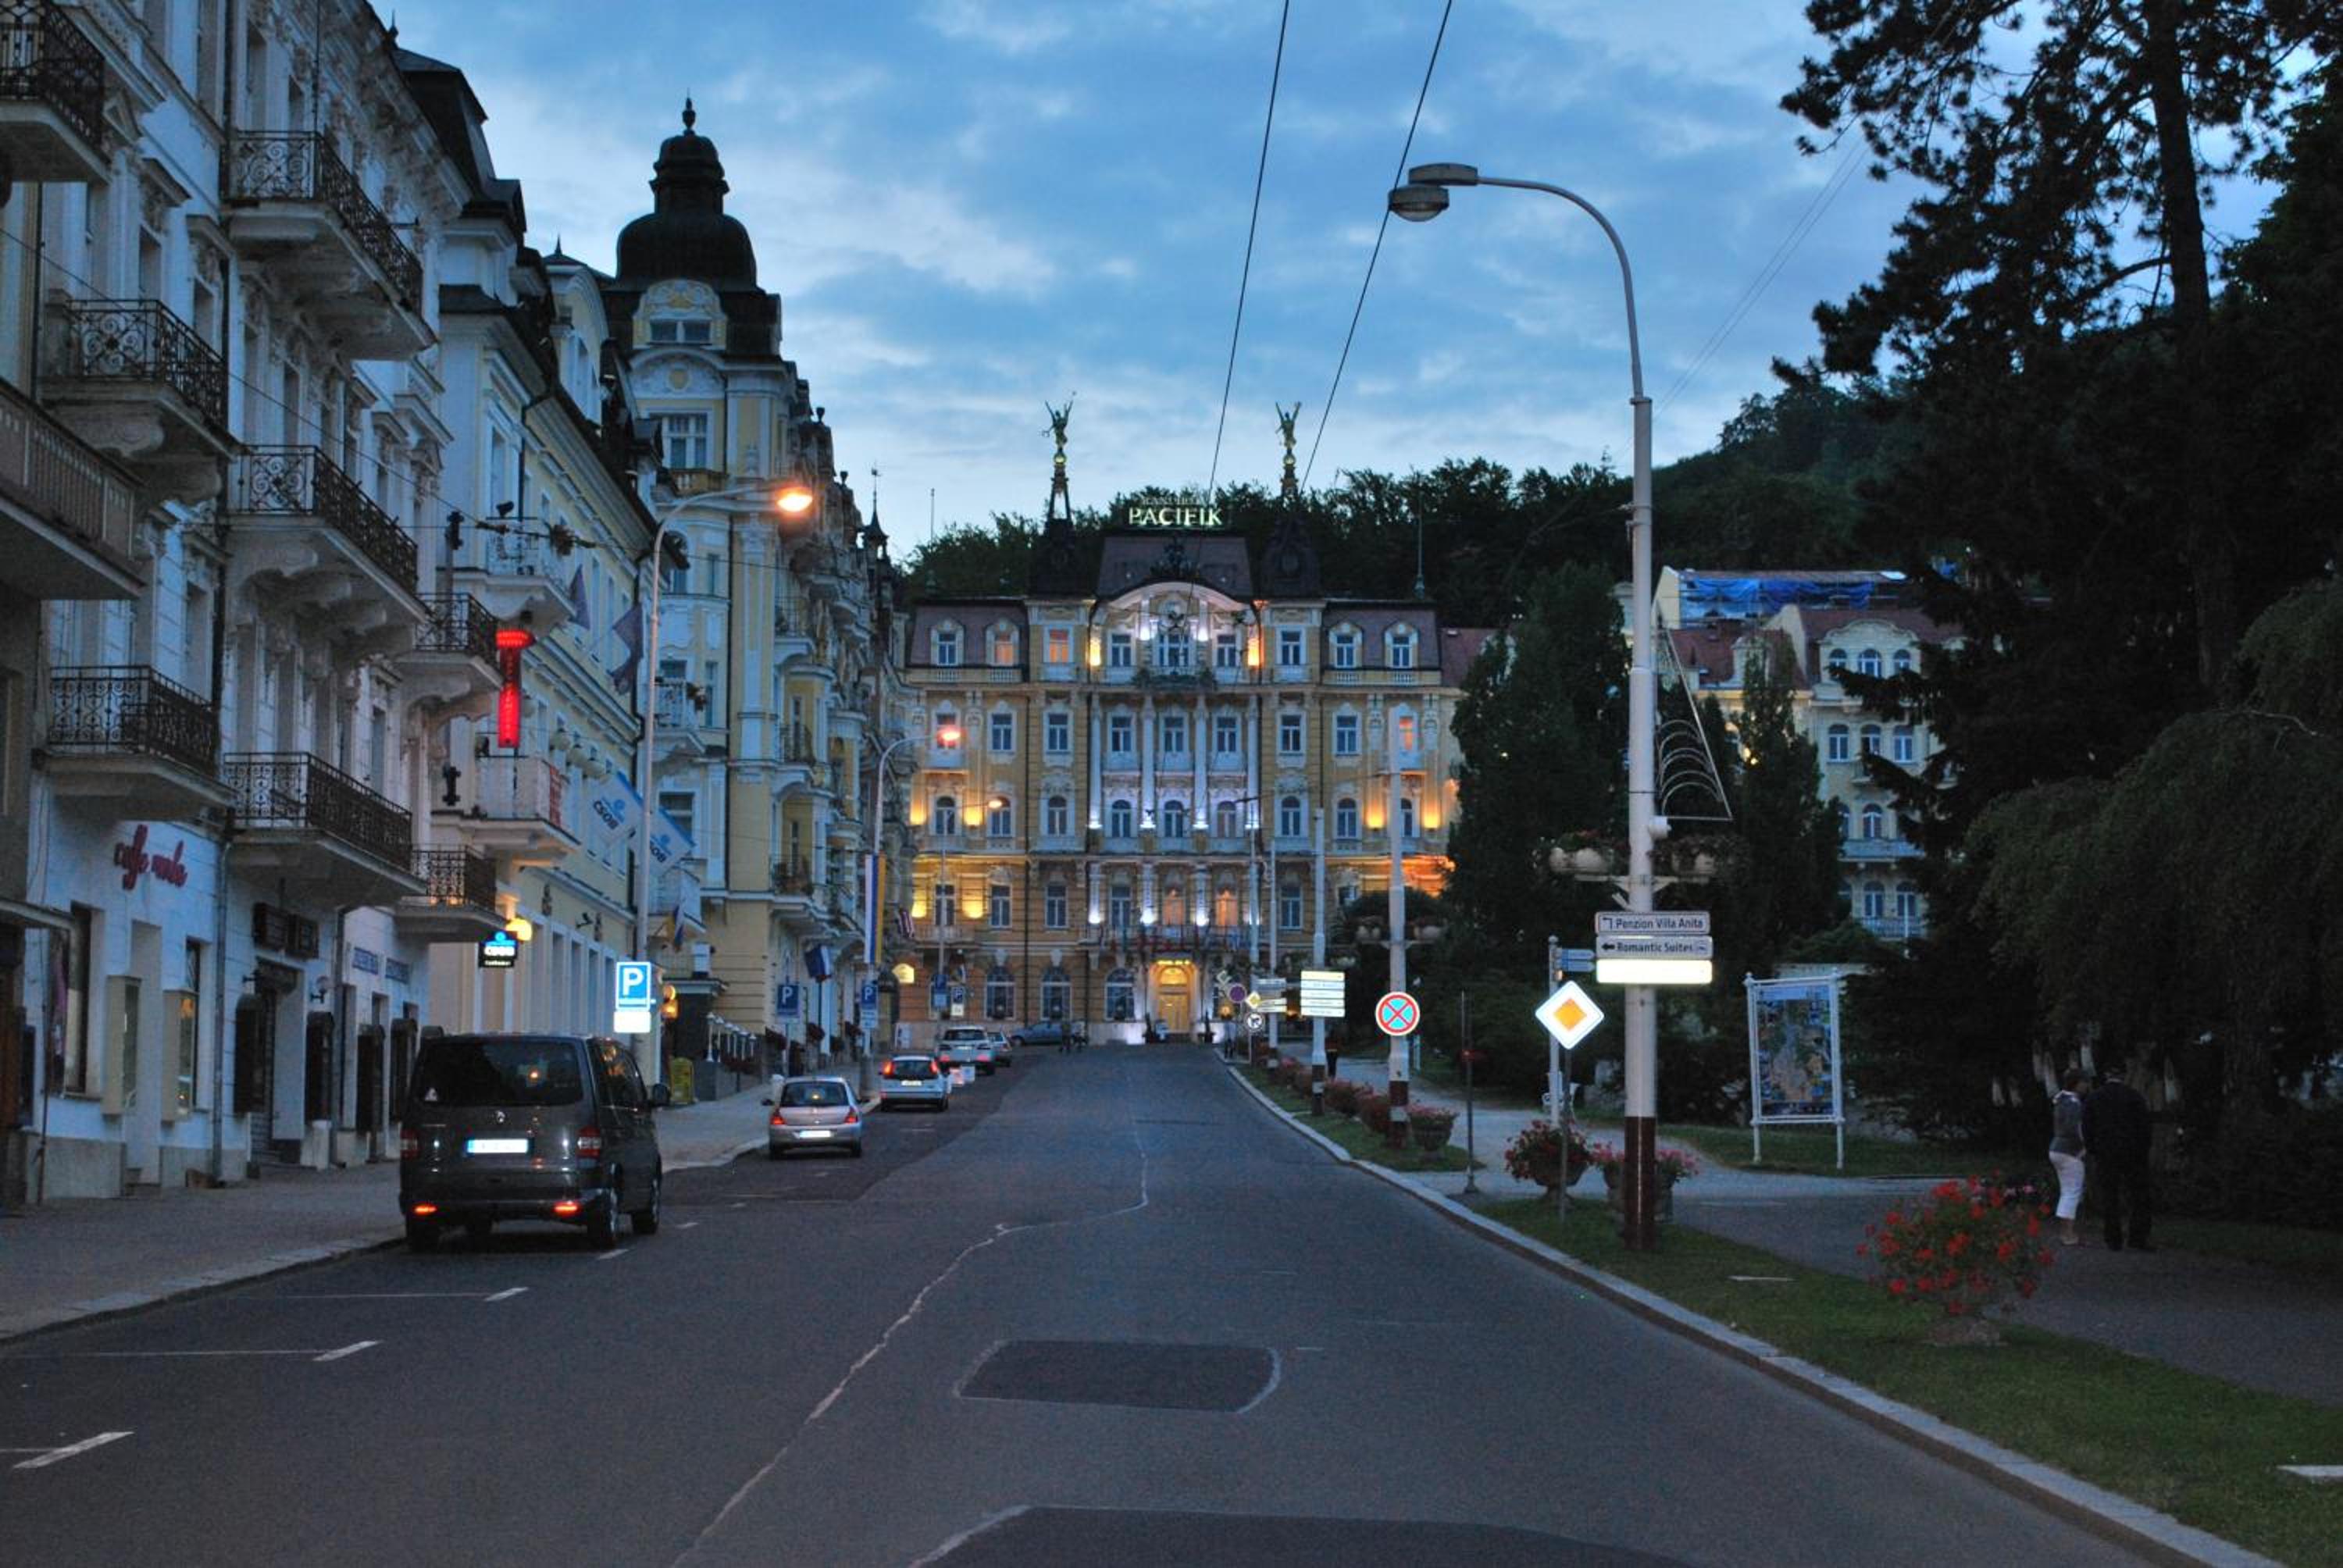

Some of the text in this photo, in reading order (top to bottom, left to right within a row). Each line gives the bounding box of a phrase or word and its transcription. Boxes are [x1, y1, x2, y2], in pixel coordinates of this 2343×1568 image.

[1129, 507, 1222, 526] PACIFIK
[1616, 917, 1703, 928] Penzion Villa Anita
[1616, 942, 1693, 952] Romantic Suites
[622, 967, 644, 996] P
[782, 985, 793, 1005] P
[864, 986, 874, 1000] P
